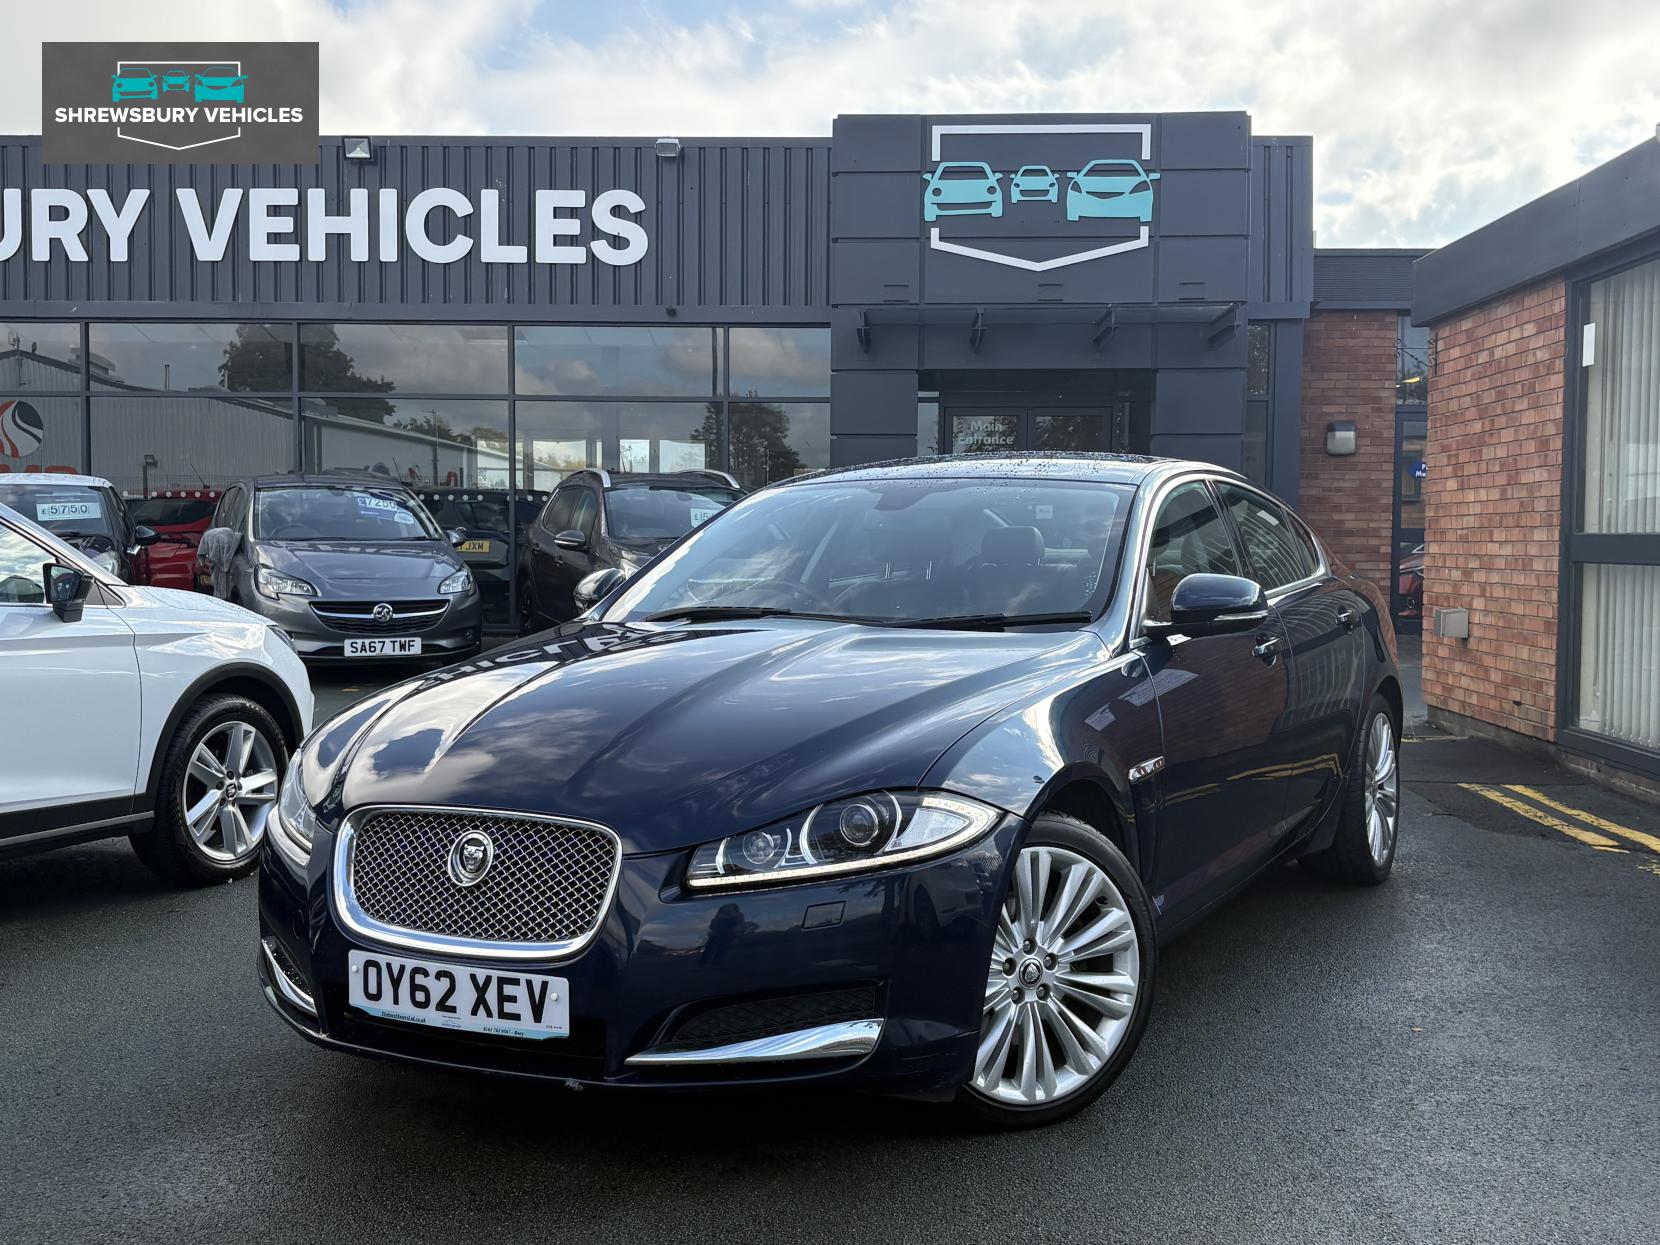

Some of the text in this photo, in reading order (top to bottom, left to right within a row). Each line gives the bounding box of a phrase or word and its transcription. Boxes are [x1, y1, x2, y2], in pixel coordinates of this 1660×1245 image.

[175, 187, 649, 266] VEHICLES
[970, 421, 1004, 431] Main
[959, 432, 1014, 444] Entrance
[41, 504, 88, 515] £5750
[350, 639, 416, 654] SA67 TWF
[363, 959, 549, 1024] OY62 XEV
